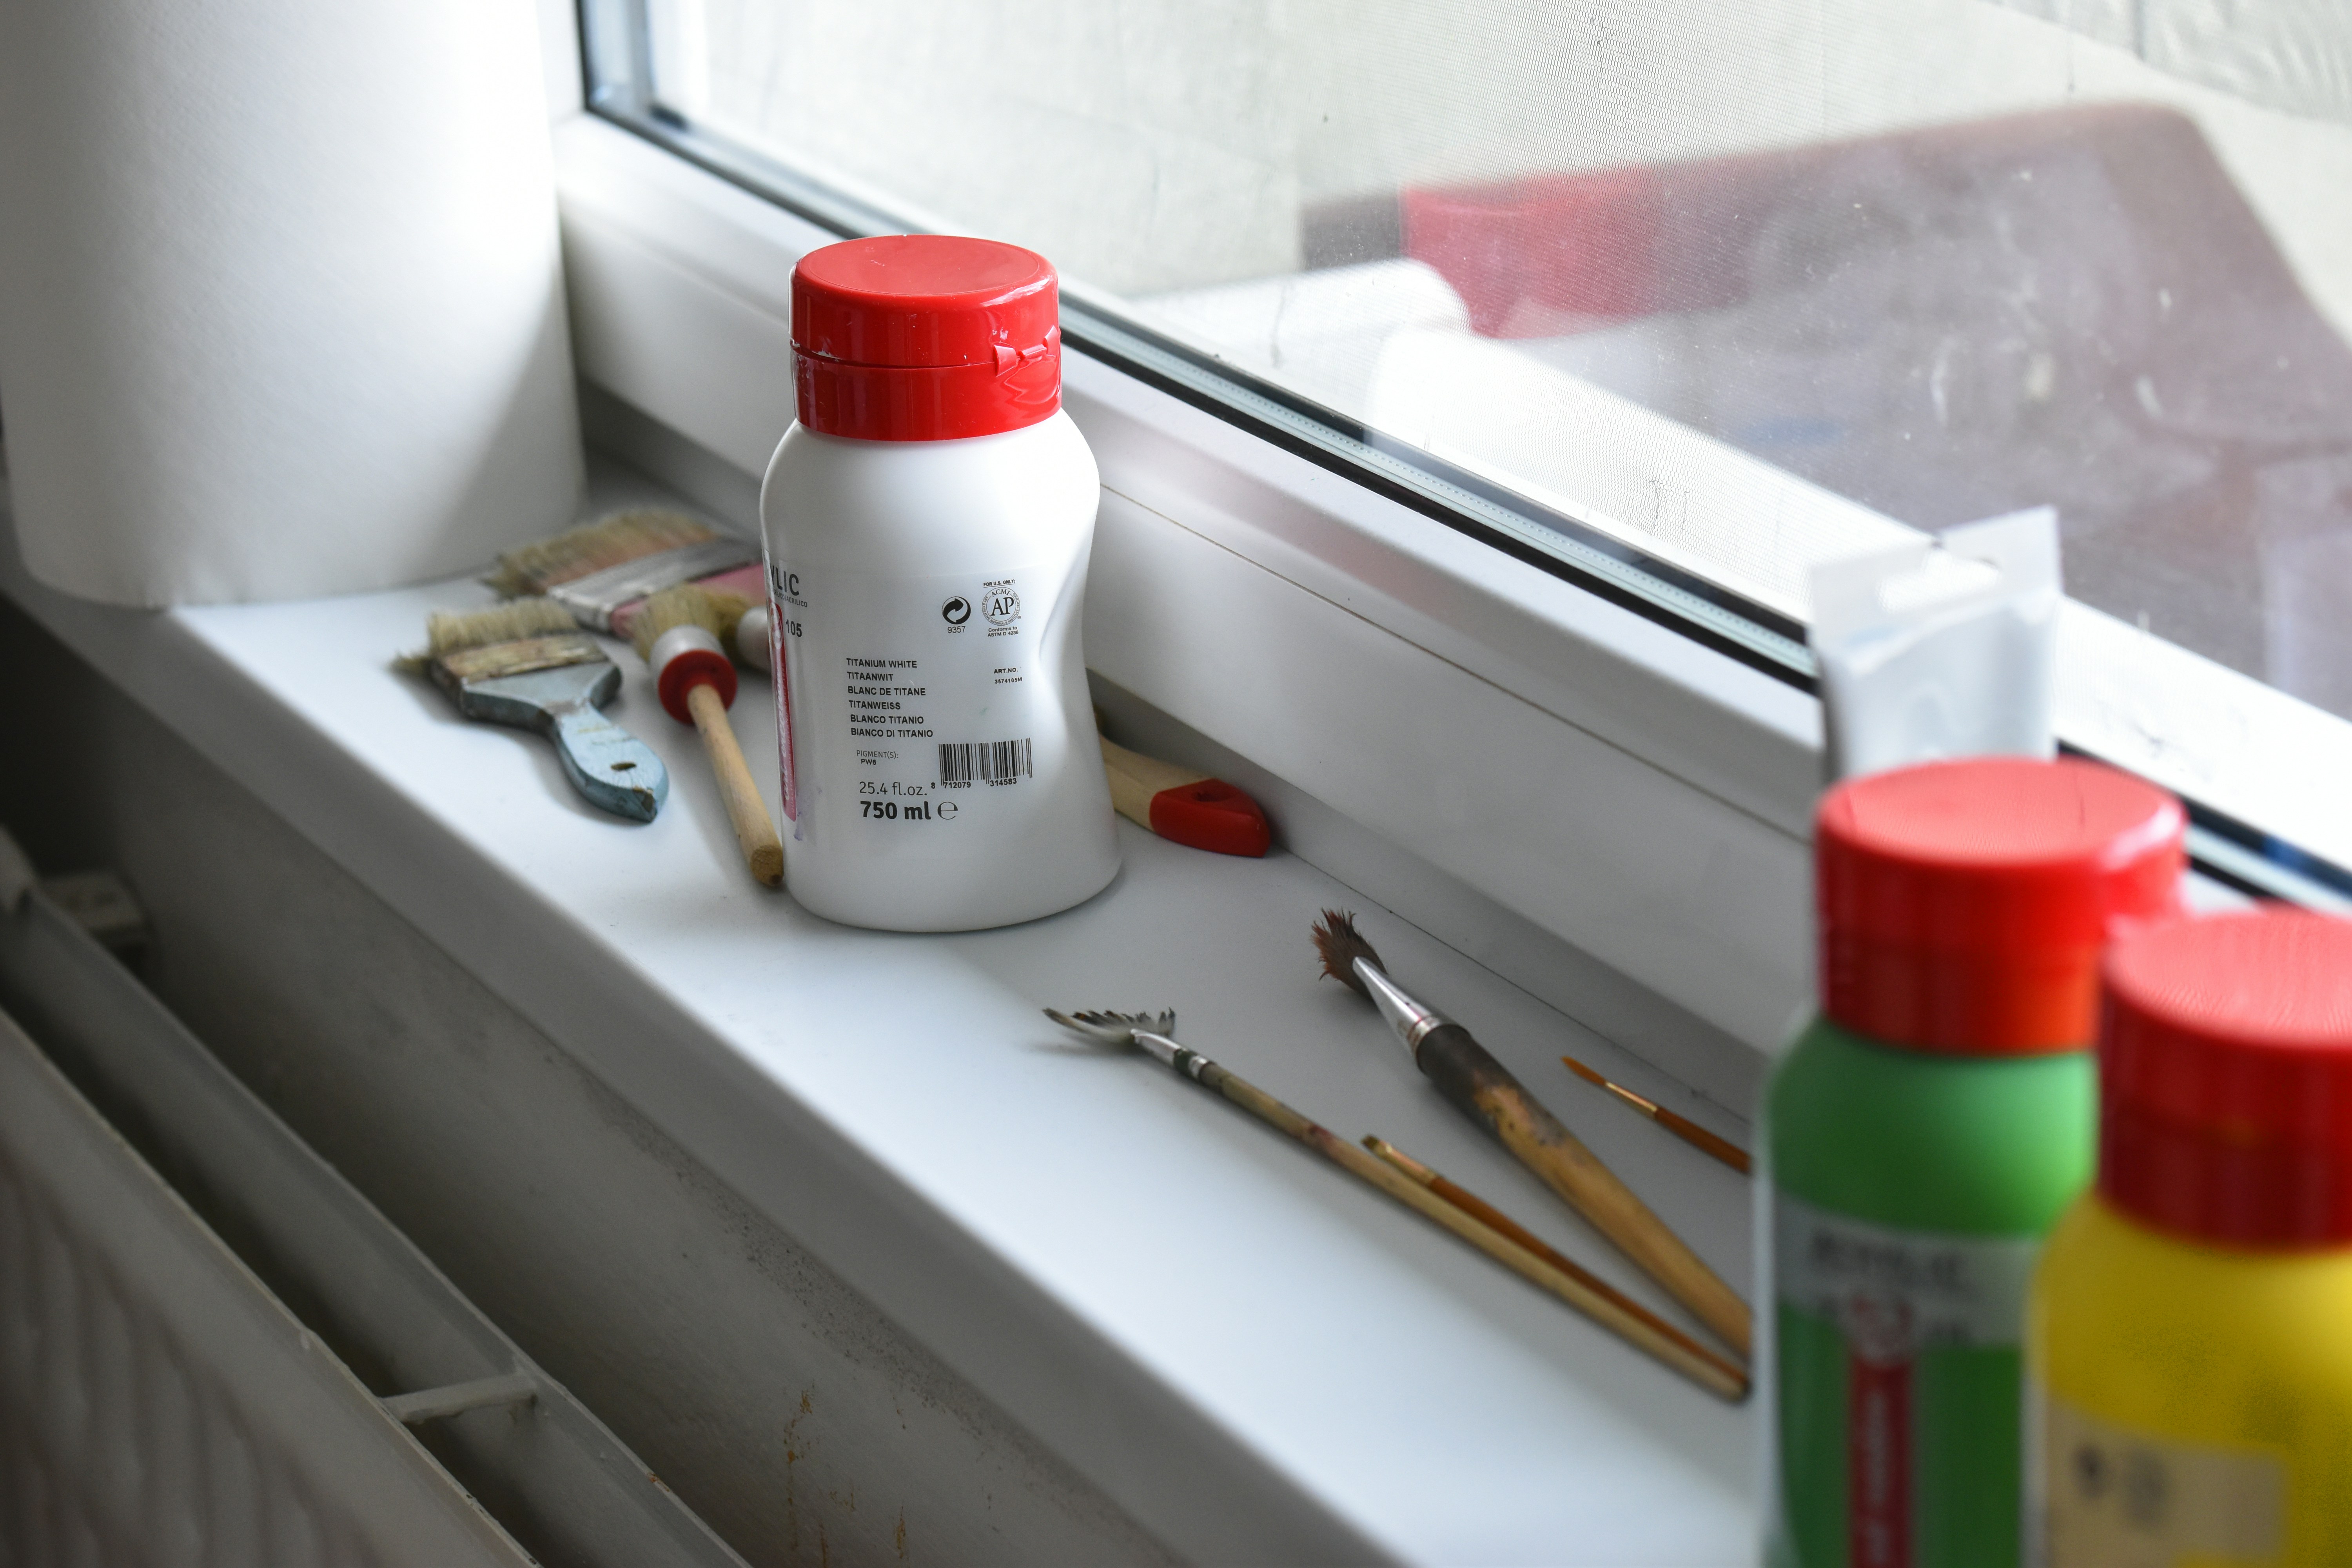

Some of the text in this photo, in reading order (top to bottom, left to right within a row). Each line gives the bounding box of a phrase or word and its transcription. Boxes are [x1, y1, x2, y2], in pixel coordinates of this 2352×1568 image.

[991, 589, 1010, 597] ACMI
[990, 597, 1014, 616] AP
[786, 619, 802, 637] 105
[846, 658, 886, 668] TITANIUM
[847, 671, 893, 681] TITAANWIT
[848, 686, 877, 695] BLANC
[849, 700, 901, 710] TITANWEISS
[850, 714, 886, 724] BLANCO
[851, 728, 884, 737] BIANCO
[857, 750, 898, 759] PIGMENT(S):
[990, 778, 1017, 787] 314583
[859, 781, 927, 796] 25.4 fl.oz.
[860, 800, 897, 819] 750
[904, 801, 931, 820] ml
